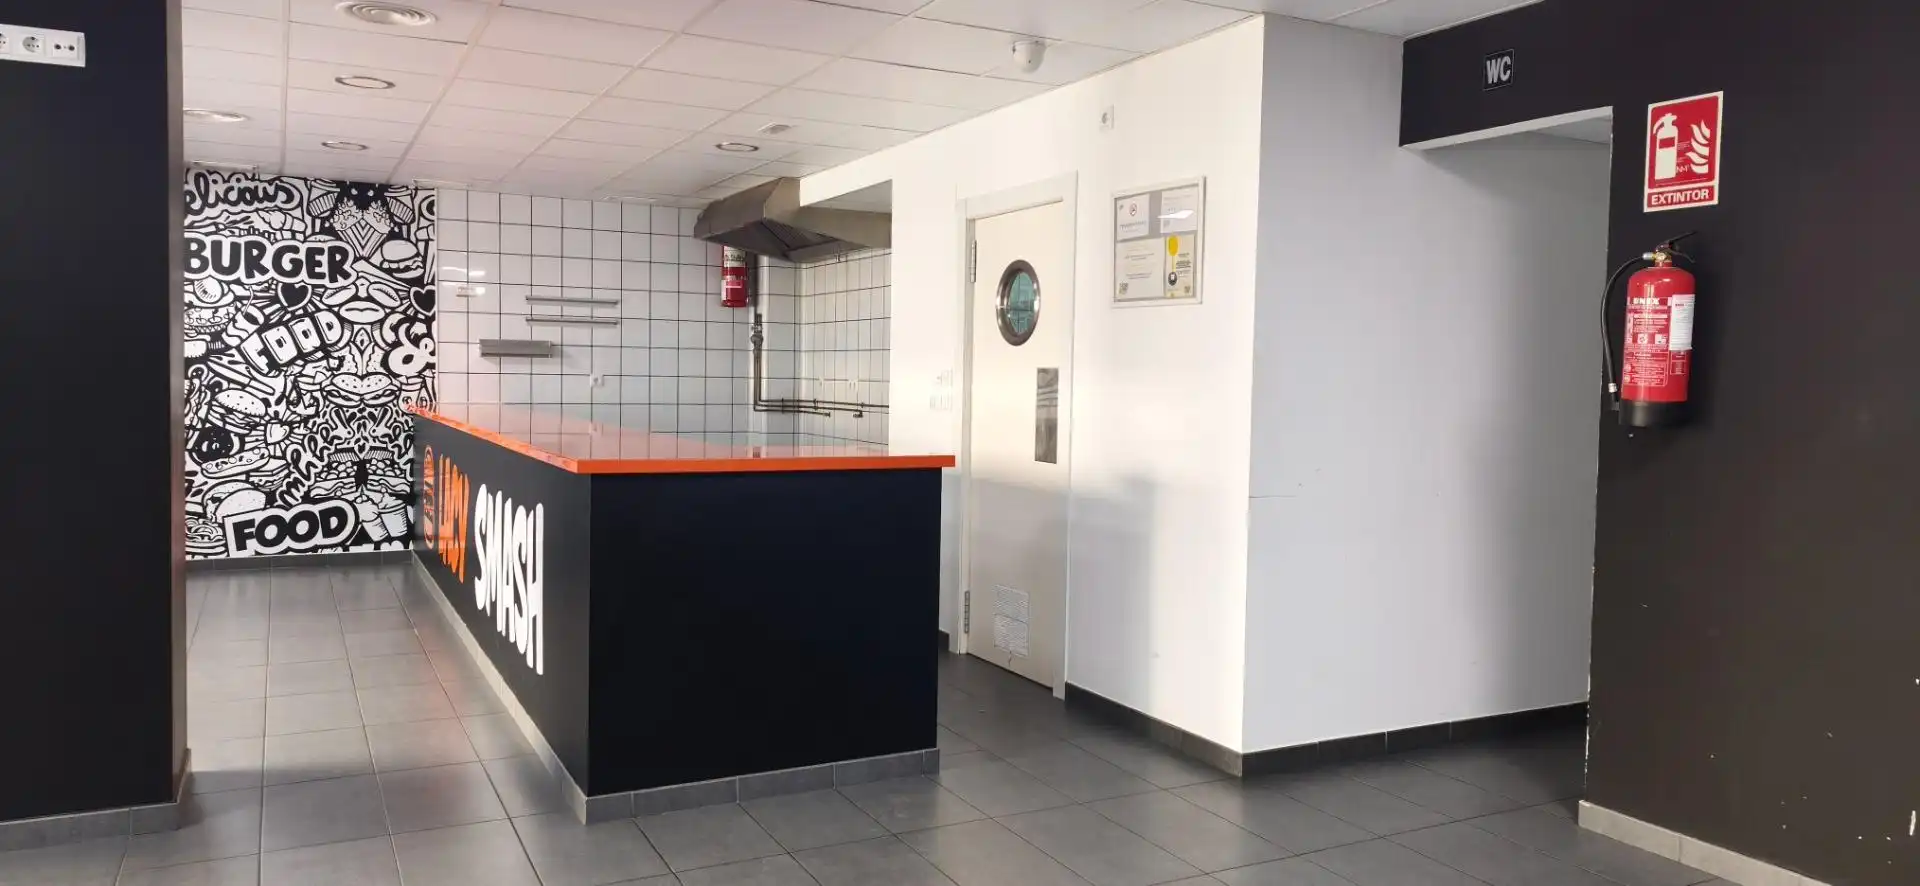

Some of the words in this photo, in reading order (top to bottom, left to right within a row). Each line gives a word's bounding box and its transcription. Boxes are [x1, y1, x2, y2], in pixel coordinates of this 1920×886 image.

[1486, 55, 1511, 84] WC
[1651, 188, 1709, 205] EXTINTOR
[184, 234, 352, 284] BURGER
[241, 310, 342, 374] FOOD
[232, 506, 348, 552] FOOD
[474, 483, 544, 675] SMASH
